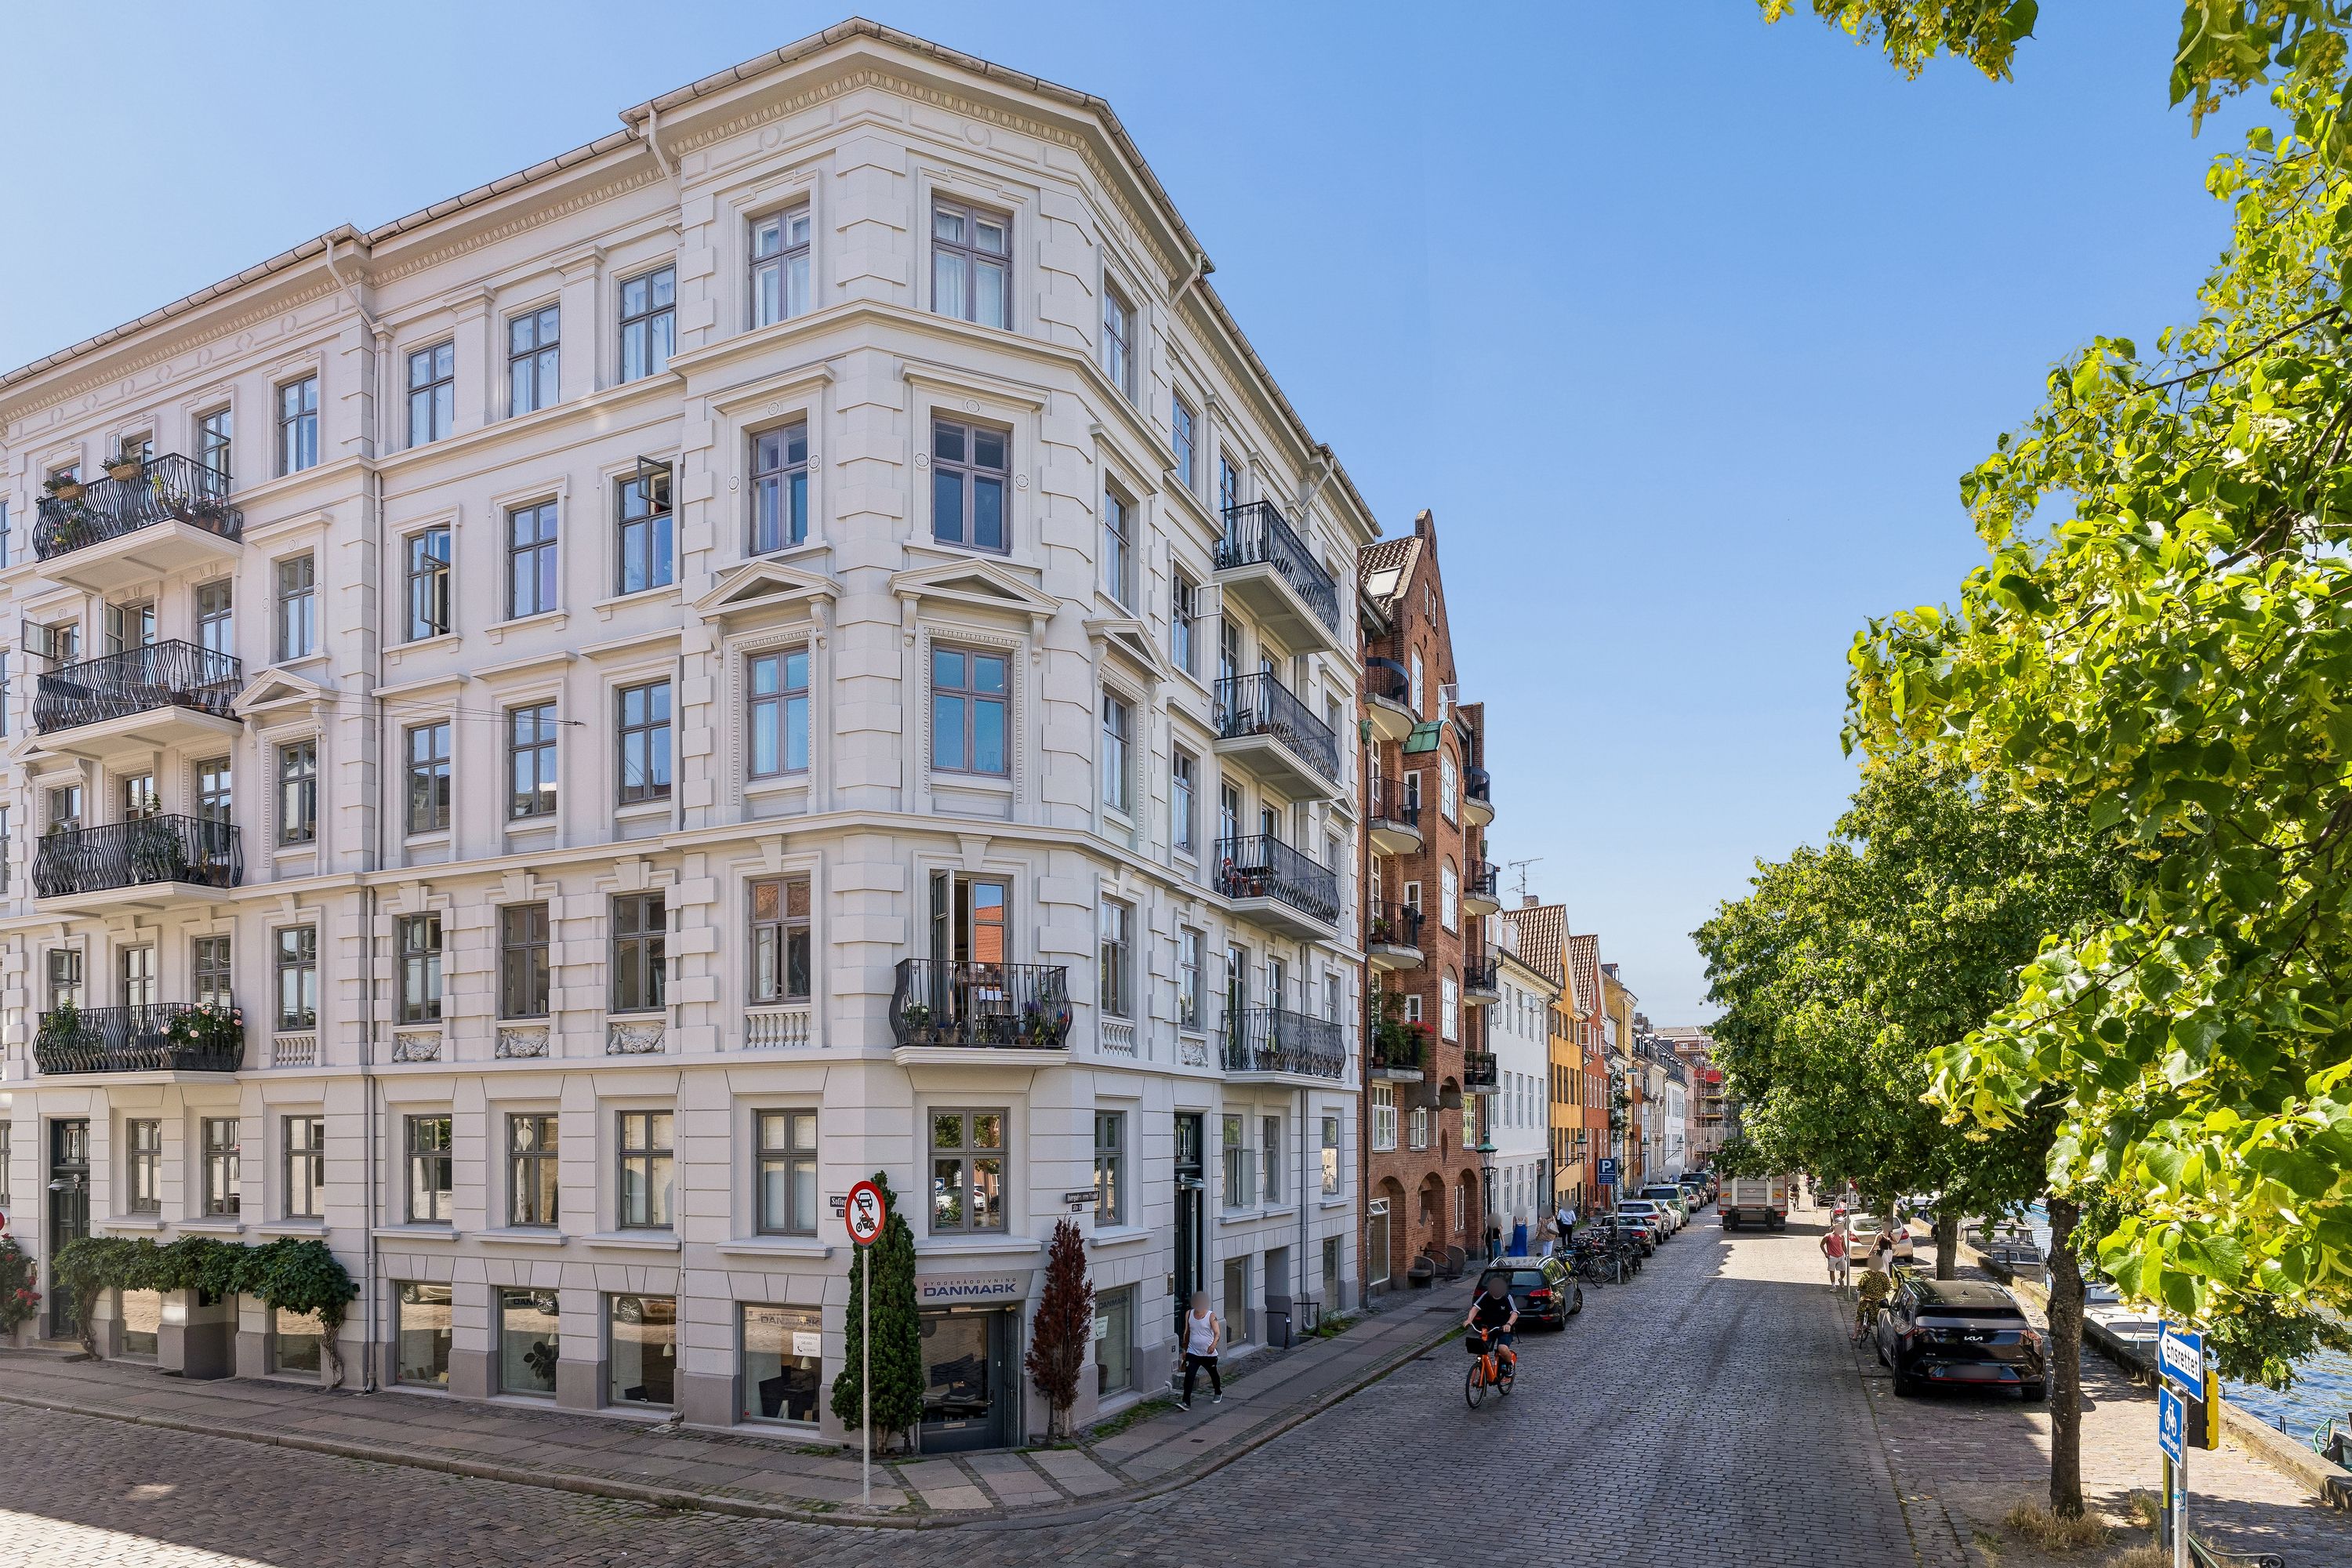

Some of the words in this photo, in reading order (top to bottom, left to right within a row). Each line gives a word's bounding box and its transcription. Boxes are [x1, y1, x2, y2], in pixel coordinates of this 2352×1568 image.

[1602, 1160, 1612, 1173] P
[924, 1277, 1017, 1287] BYGGERÅDGIVNING
[924, 1283, 1017, 1298] DANMARK
[2167, 1338, 2198, 1377] Ensrettet
